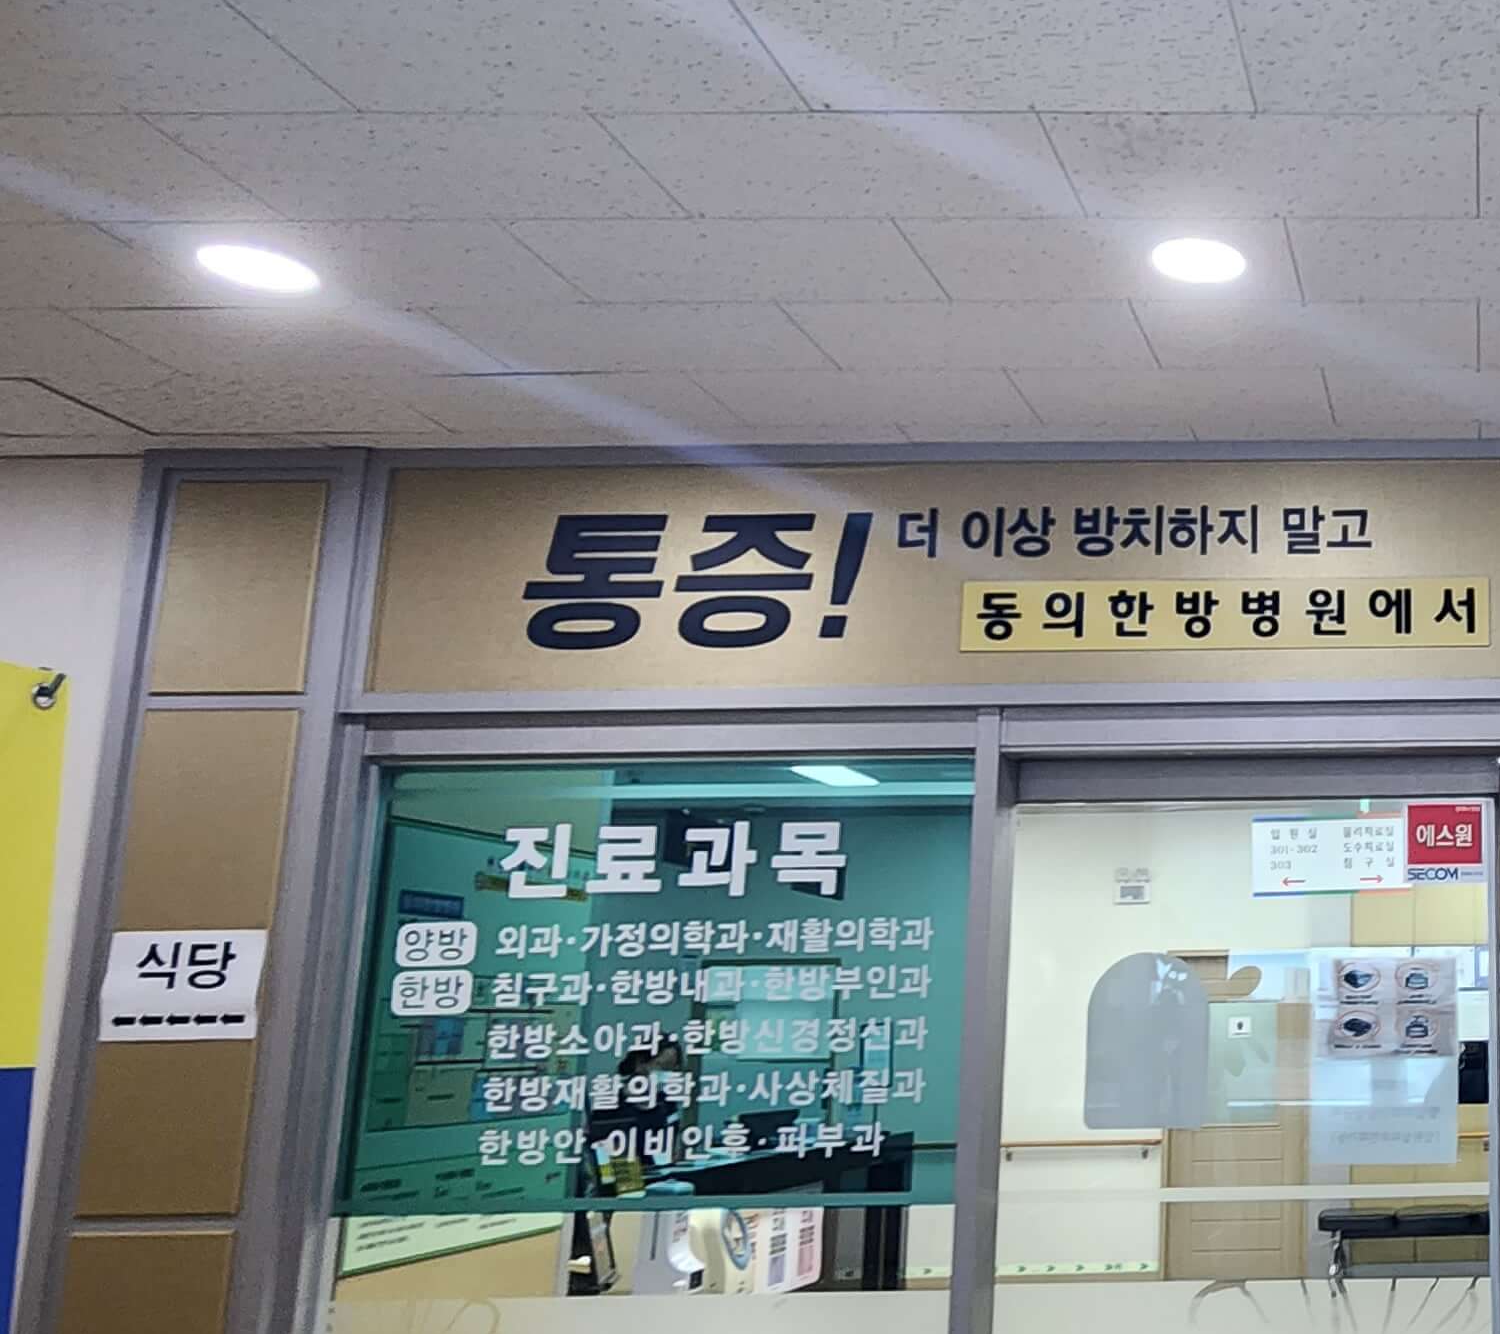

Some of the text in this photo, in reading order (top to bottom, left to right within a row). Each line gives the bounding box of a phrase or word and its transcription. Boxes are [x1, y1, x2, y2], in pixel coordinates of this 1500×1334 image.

[898, 504, 1372, 560] 더 이상 방치하지 말고
[522, 511, 873, 650] 통증!
[1415, 823, 1473, 847] 에스원
[500, 820, 847, 899] 진료과목
[1408, 867, 1459, 881] SECOM
[136, 940, 237, 990] 식당
[404, 925, 468, 962] 양방
[398, 972, 464, 1010] 한방
